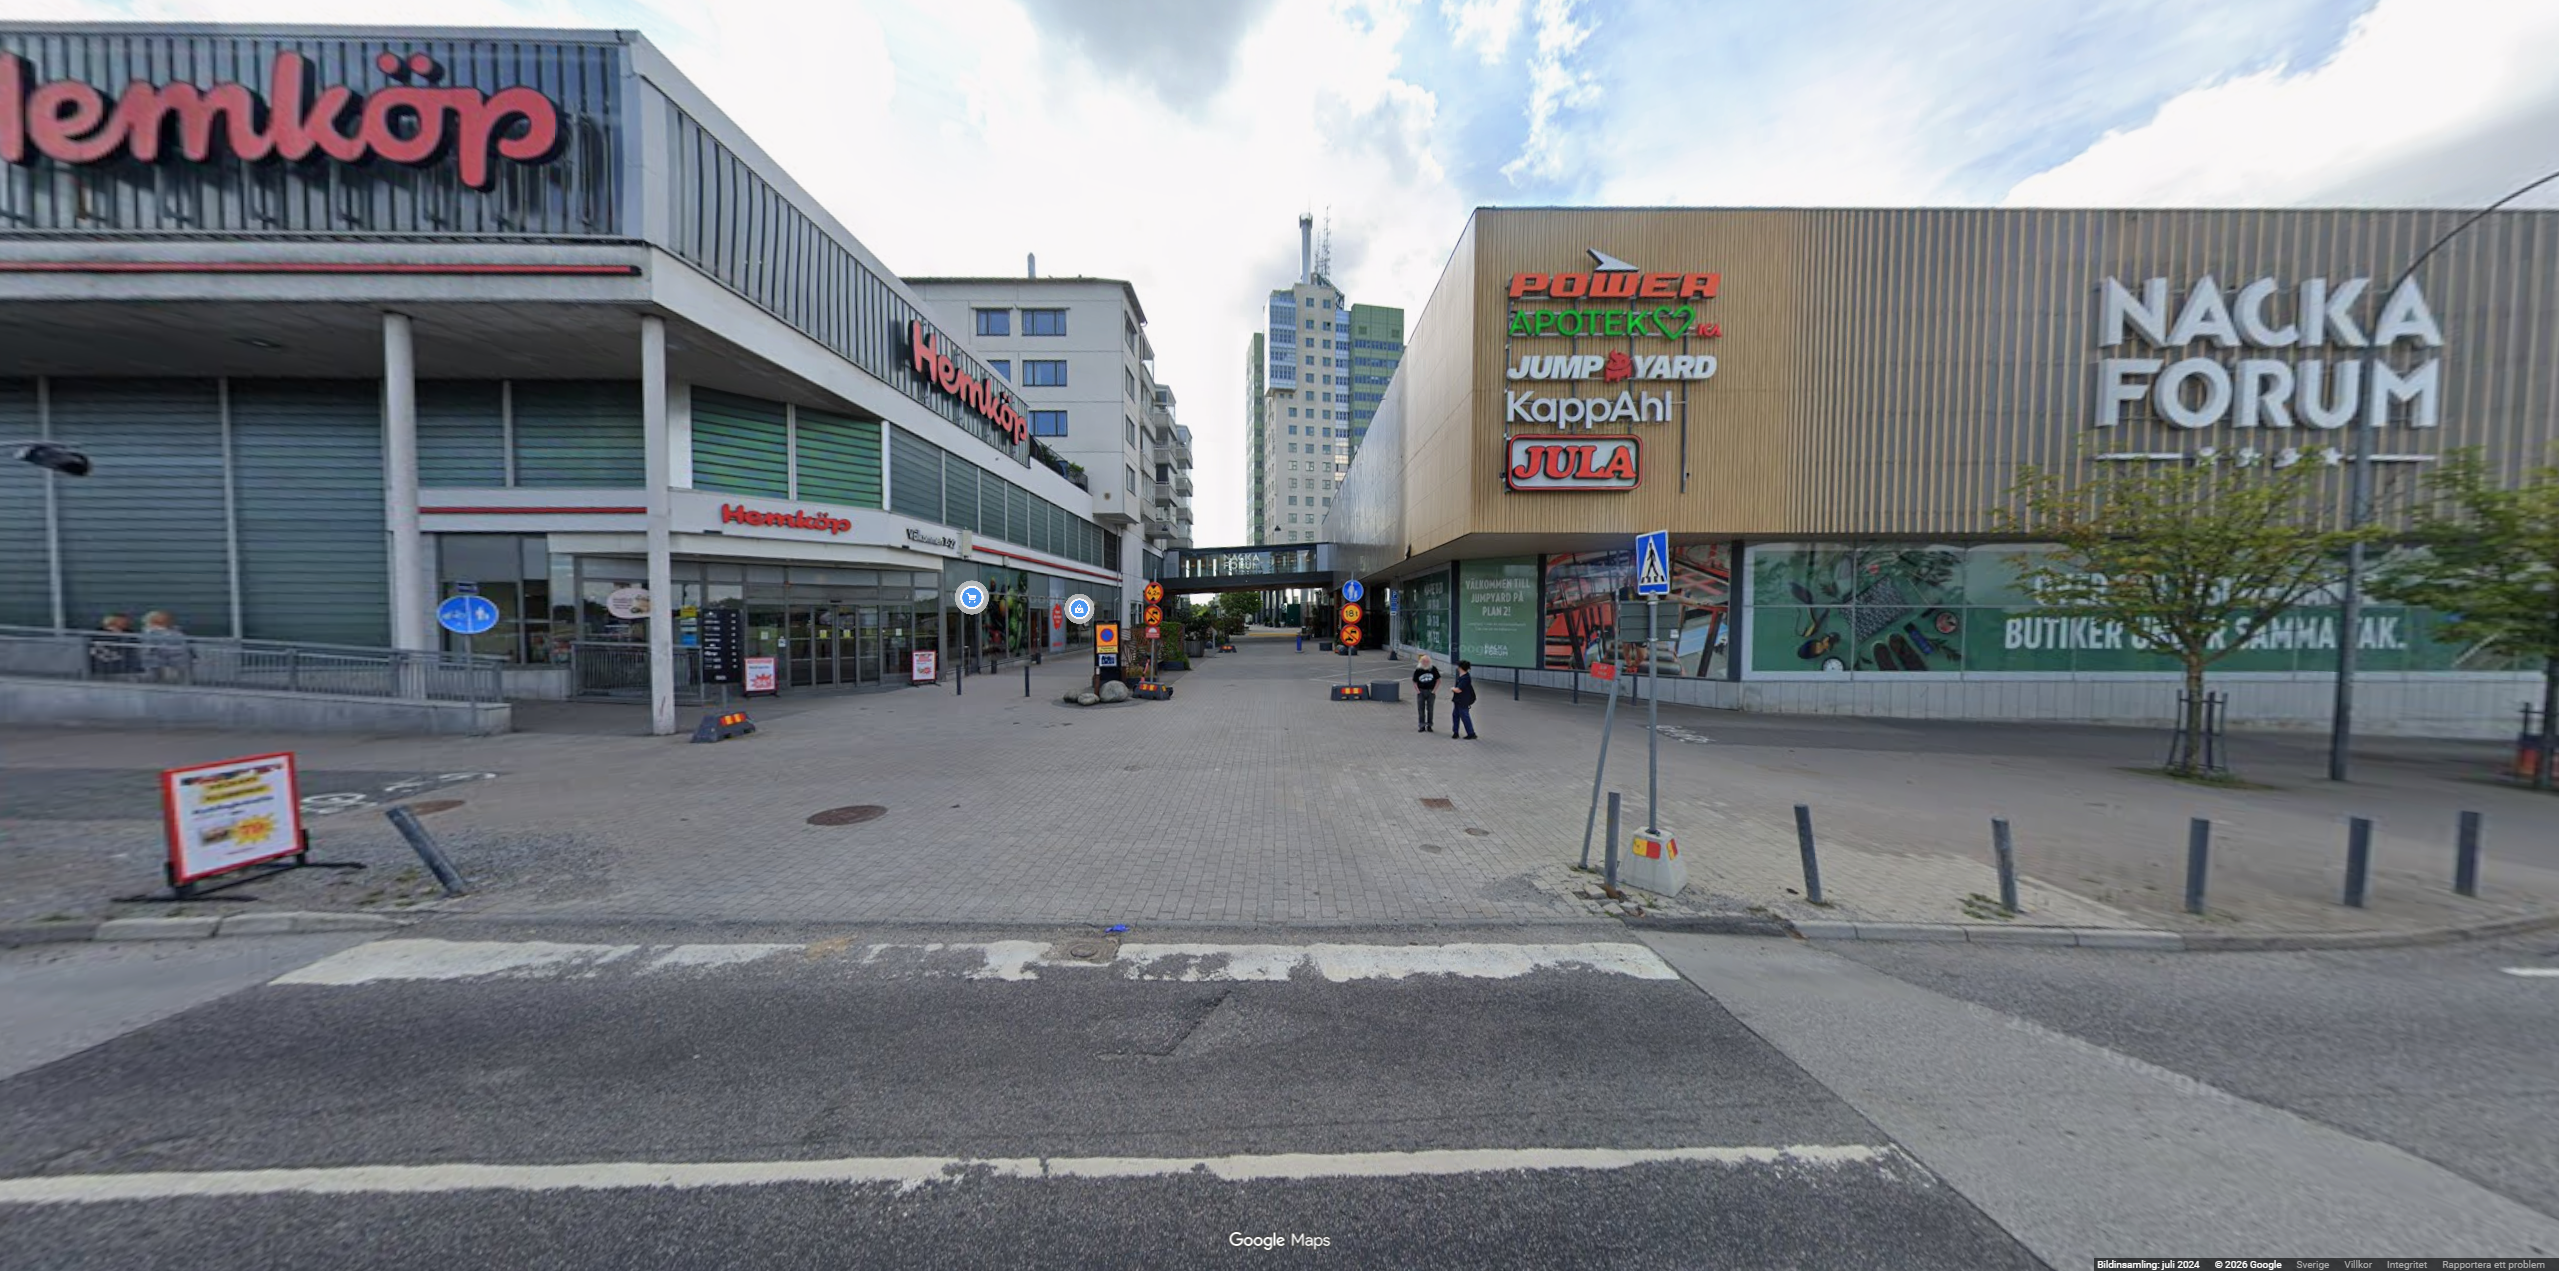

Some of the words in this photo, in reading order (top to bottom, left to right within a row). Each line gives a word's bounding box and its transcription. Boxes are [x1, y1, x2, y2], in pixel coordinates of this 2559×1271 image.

[1509, 273, 1721, 298] POWER
[1509, 309, 1650, 336] APOTEK
[1697, 323, 1722, 338] ICA
[2099, 274, 2444, 348] NACKA
[912, 319, 1028, 445] Hemköp
[1507, 355, 1605, 379] JUMP
[1632, 355, 1718, 379] YARD
[2095, 357, 2439, 430] FORUM
[1506, 390, 1672, 429] KappAhl
[1512, 446, 1637, 479] JULA
[721, 503, 852, 535] Hemköp
[1223, 553, 1260, 562] NACKA
[1466, 578, 1512, 590] VÄLKOMMEN
[1514, 578, 1531, 589] TILL
[1471, 592, 1511, 603] JUMPYARD
[1513, 590, 1524, 602] PÅ
[1482, 606, 1502, 617] PLAN
[1503, 606, 1511, 617] 2!
[2005, 616, 2124, 649] BUTIKER
[2235, 616, 2337, 649] SAMMA
[2356, 616, 2407, 649] AK.
